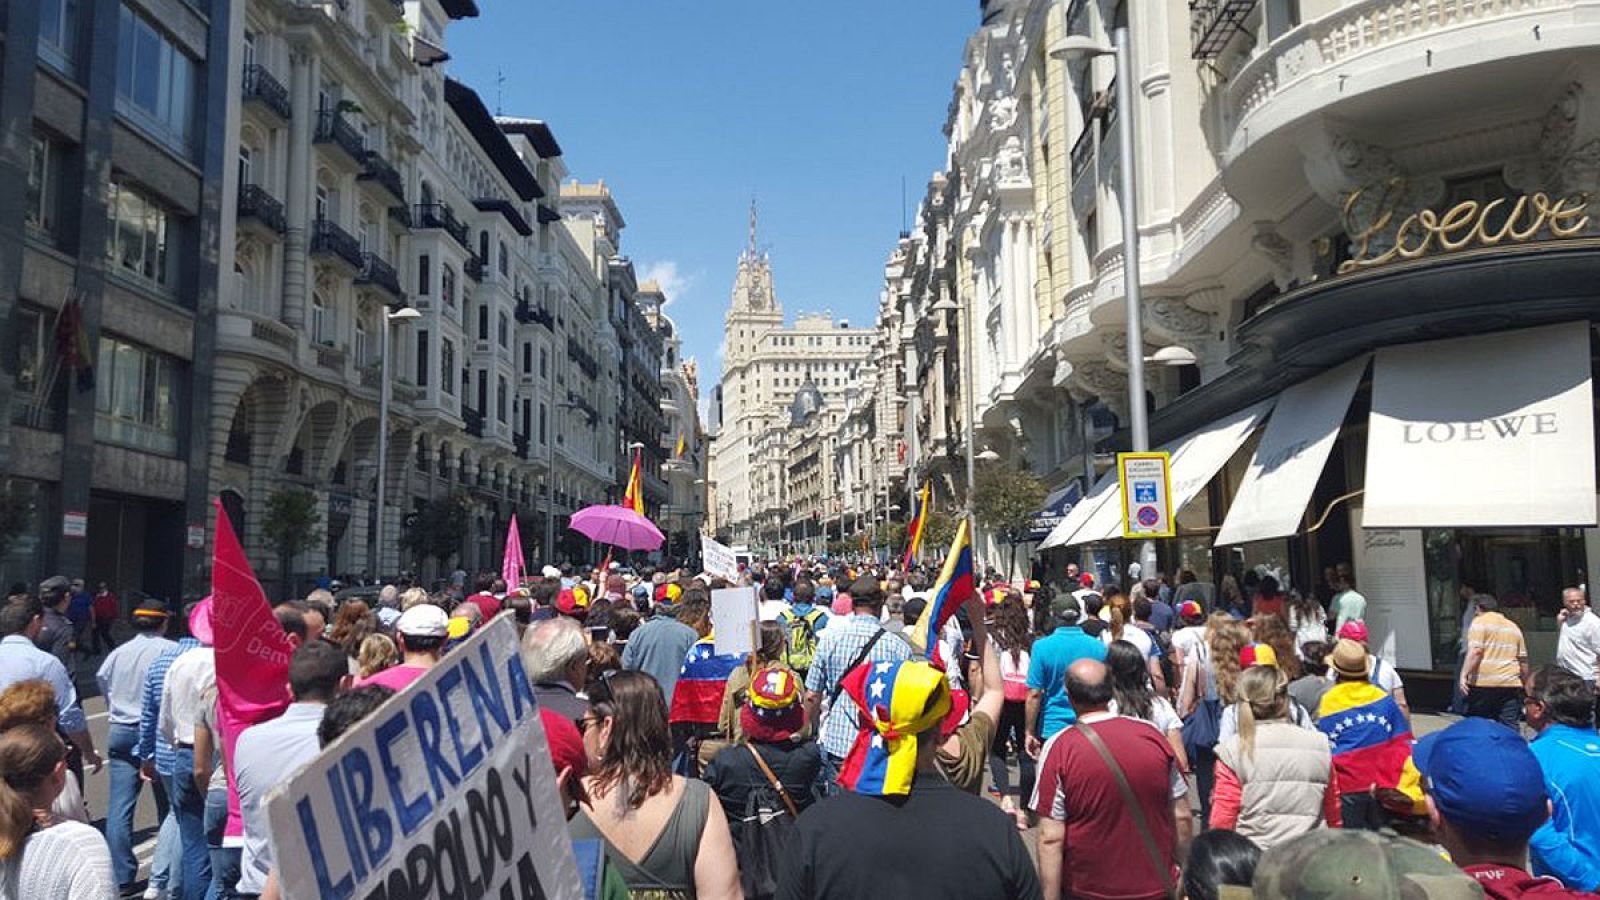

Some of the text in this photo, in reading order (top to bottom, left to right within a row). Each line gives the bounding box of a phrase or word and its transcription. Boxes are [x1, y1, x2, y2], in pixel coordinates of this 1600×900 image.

[1337, 178, 1590, 274] Loewe
[1403, 412, 1559, 444] LOEWE
[512, 752, 538, 832] Y
